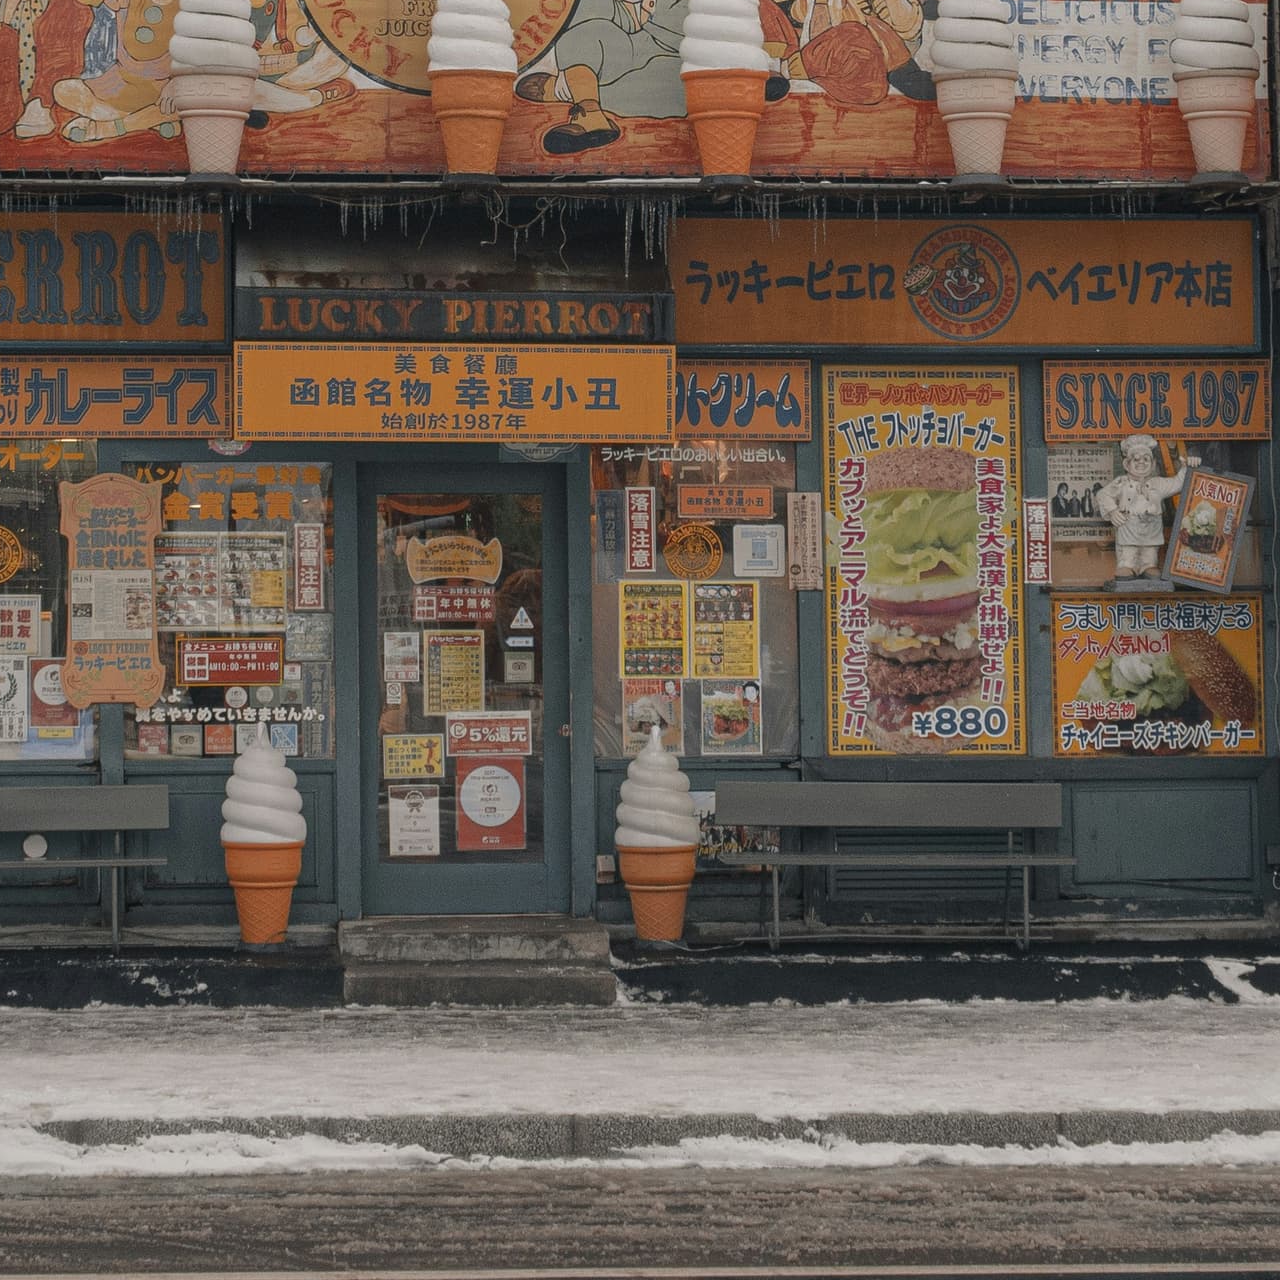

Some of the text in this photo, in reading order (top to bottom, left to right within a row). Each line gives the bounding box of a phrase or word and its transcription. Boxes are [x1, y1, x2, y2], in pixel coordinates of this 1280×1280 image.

[375, 19, 432, 37] JUIC
[1015, 33, 1125, 65] NERGY
[1016, 76, 1171, 106] VERYONE
[920, 231, 1011, 269] HAMBURGER
[685, 260, 1233, 308] ラッキーピエロ ベイエリア本店
[258, 296, 652, 337] LUCKY PIERROT
[918, 277, 1017, 333] LUCKY PIERROT
[393, 353, 518, 375] 美食餐廳
[23, 367, 221, 426] カレーライス
[289, 377, 621, 410] 函館名物 幸運小丑
[676, 372, 802, 428] トクリーム
[1055, 370, 1260, 429] SINCE 1987
[380, 412, 527, 431] 始創於1987年
[837, 410, 1006, 455] THE フトッチョバーガー
[631, 492, 651, 568] 落雪注意
[299, 530, 319, 605] 落雪注意
[1056, 601, 1254, 633] うまい門には福来たる
[74, 656, 152, 671] ラッキーピエロ
[1056, 632, 1173, 663] ダントツ人気No.1
[912, 706, 1008, 738] ¥880
[1061, 701, 1137, 721] ご当地名物
[470, 726, 528, 743] 5%還元
[1060, 721, 1256, 752] チャイニーズチキンバーガー
